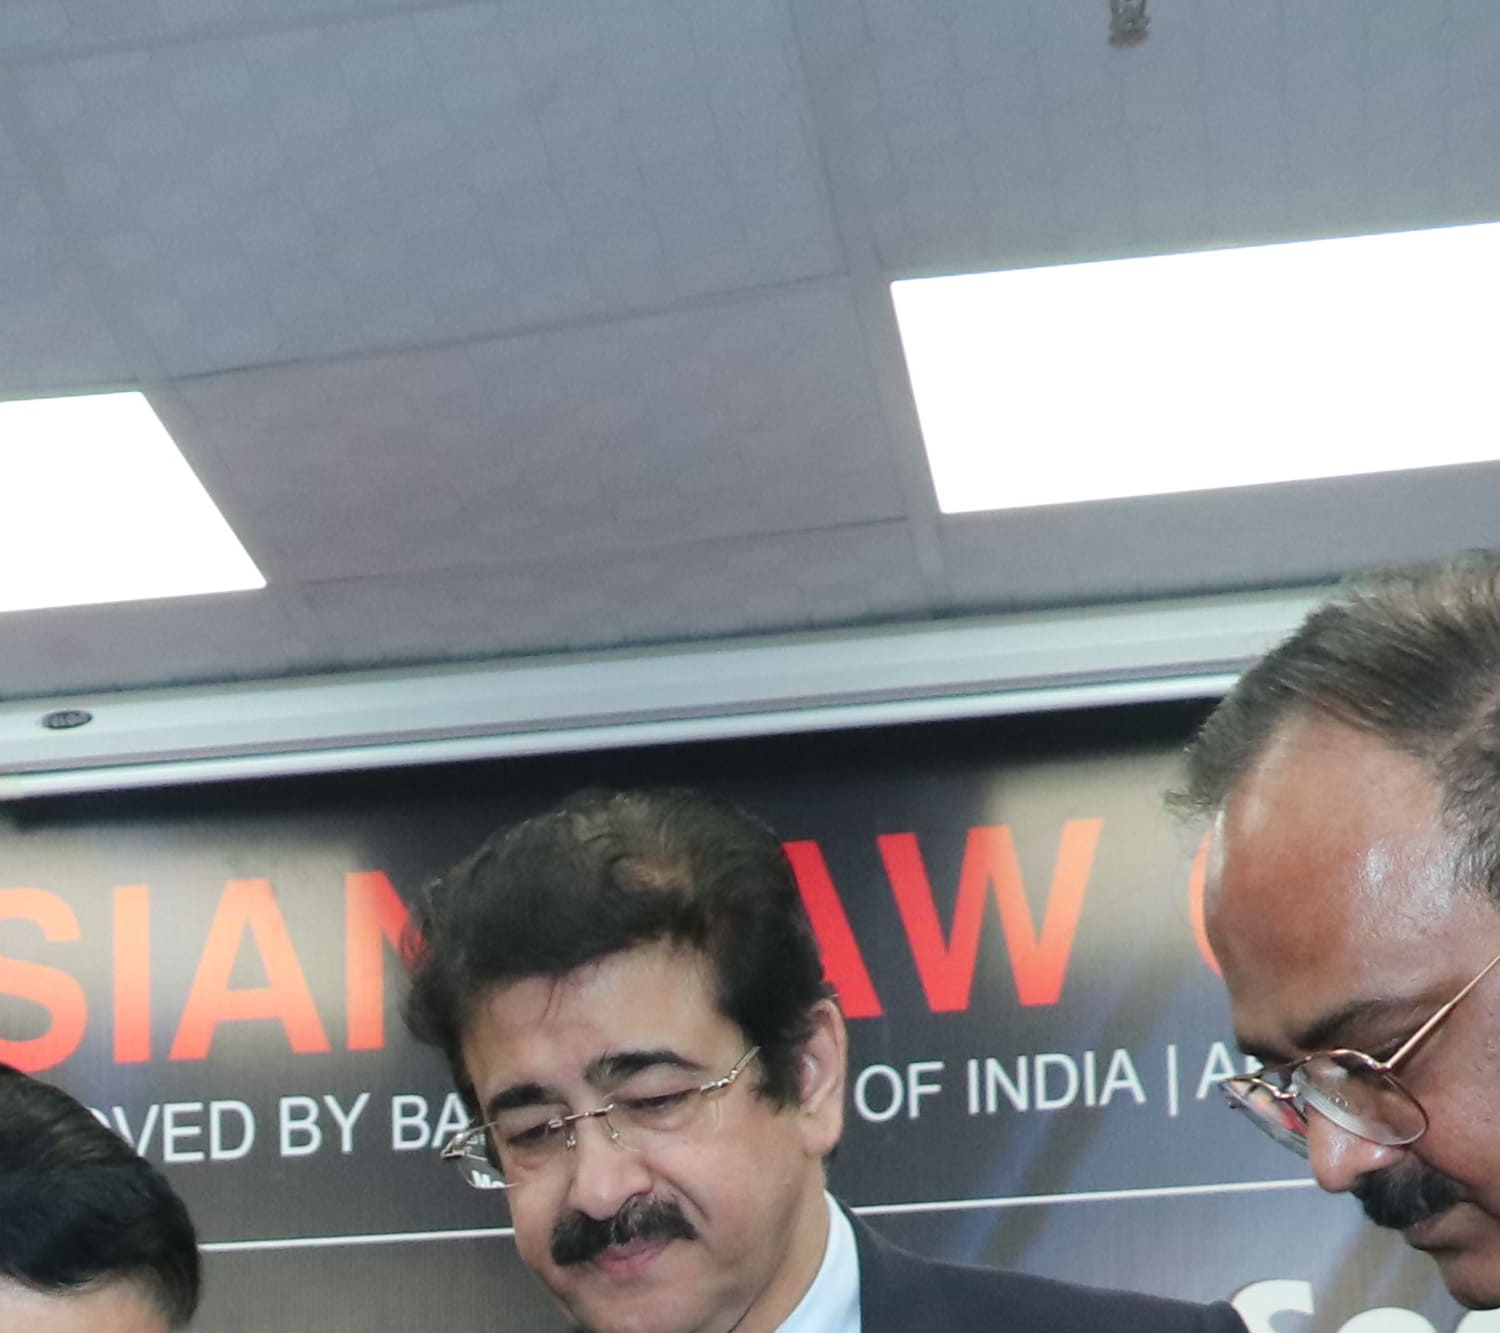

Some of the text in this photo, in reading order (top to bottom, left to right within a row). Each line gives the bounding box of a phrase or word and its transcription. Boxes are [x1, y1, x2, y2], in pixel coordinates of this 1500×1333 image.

[86, 1099, 256, 1163] VED
[279, 1092, 371, 1158] BY
[854, 1062, 943, 1122] OF
[968, 1049, 1146, 1115] INDIA
